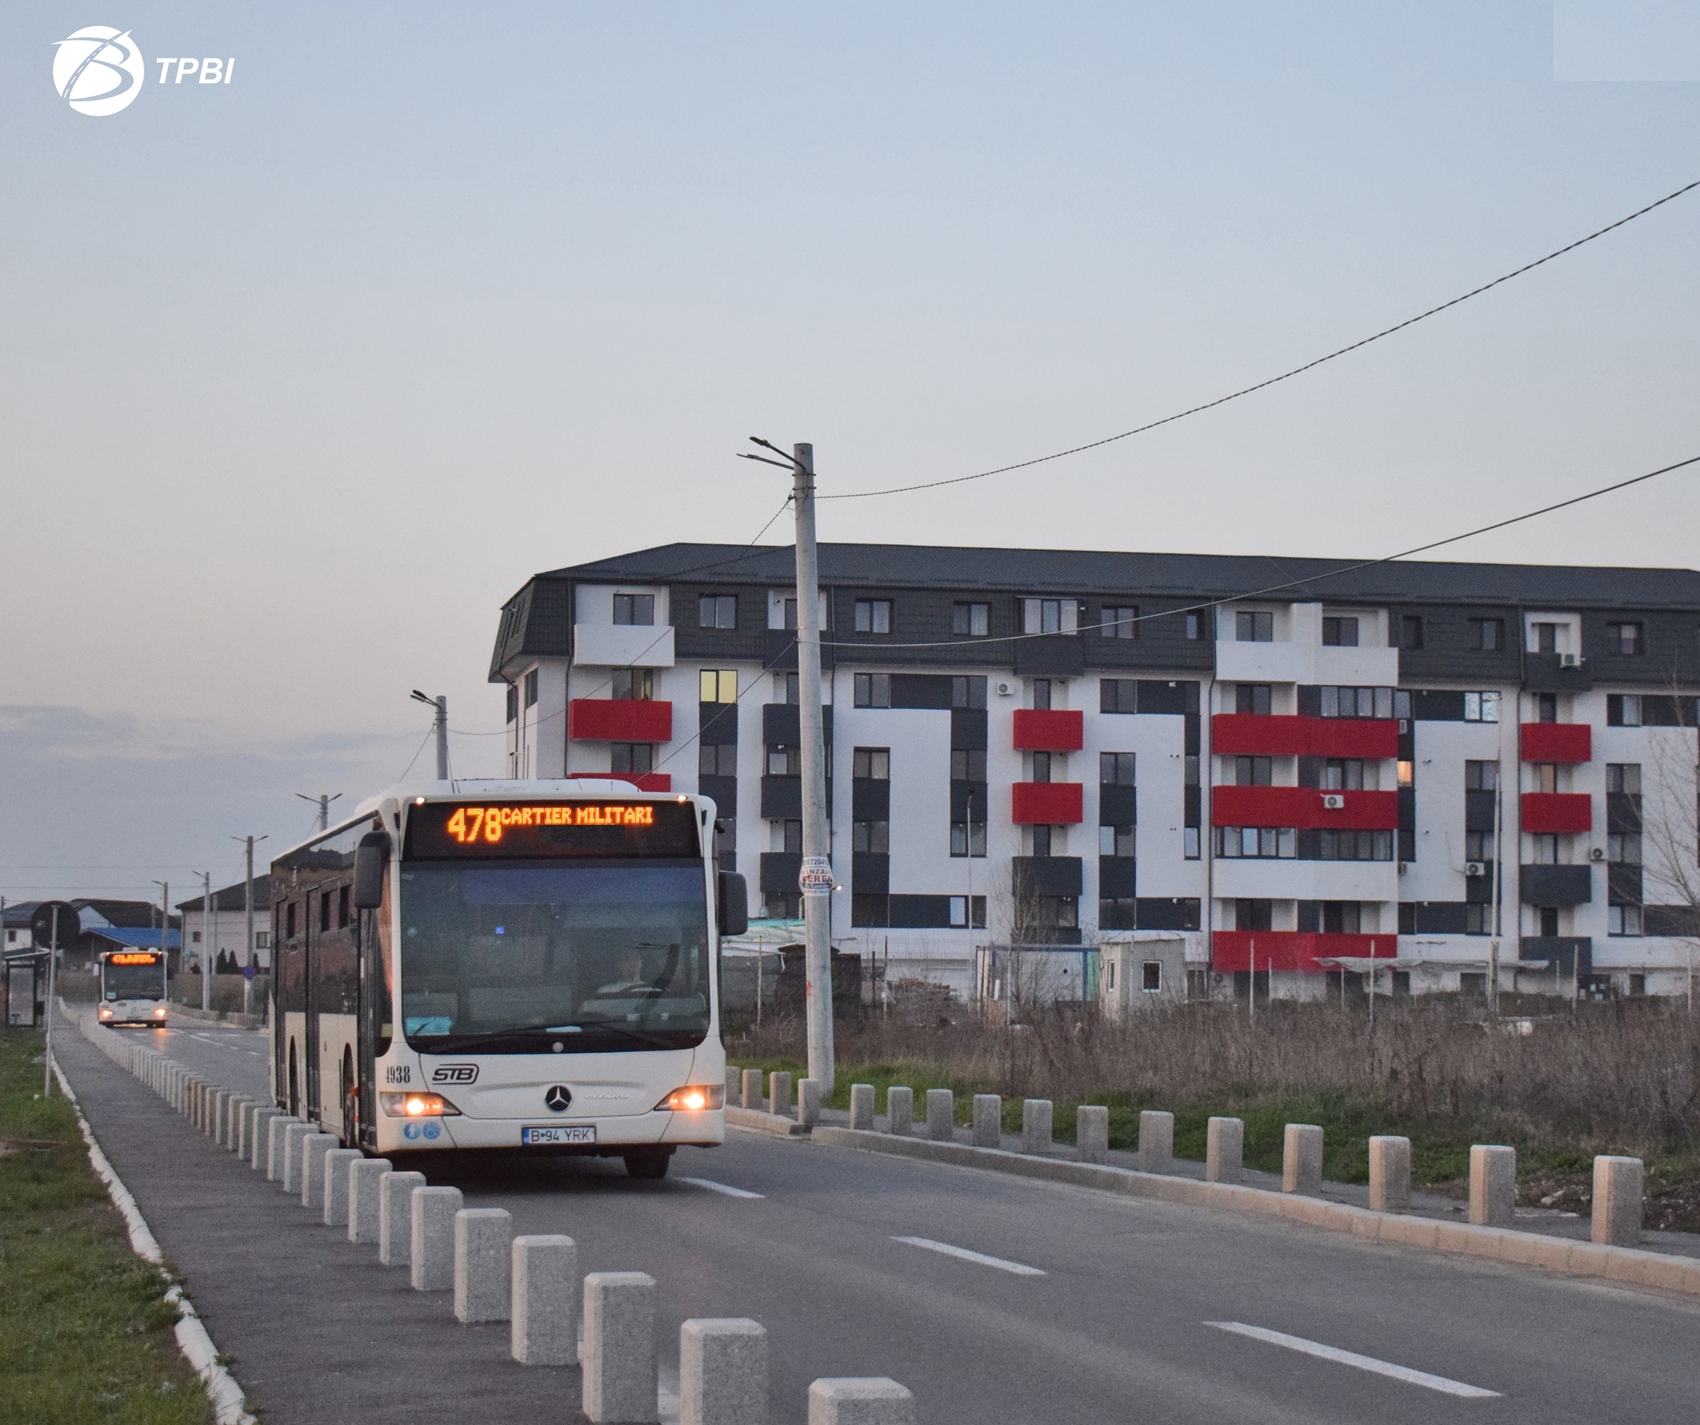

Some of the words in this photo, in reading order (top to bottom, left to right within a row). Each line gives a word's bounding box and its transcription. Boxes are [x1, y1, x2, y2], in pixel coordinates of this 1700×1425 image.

[447, 807, 502, 842] 478
[501, 806, 571, 825] CARTIER
[577, 806, 653, 824] MILITARI
[385, 1065, 411, 1084] 4938
[432, 1067, 475, 1081] STB
[565, 1130, 590, 1142] YRK
